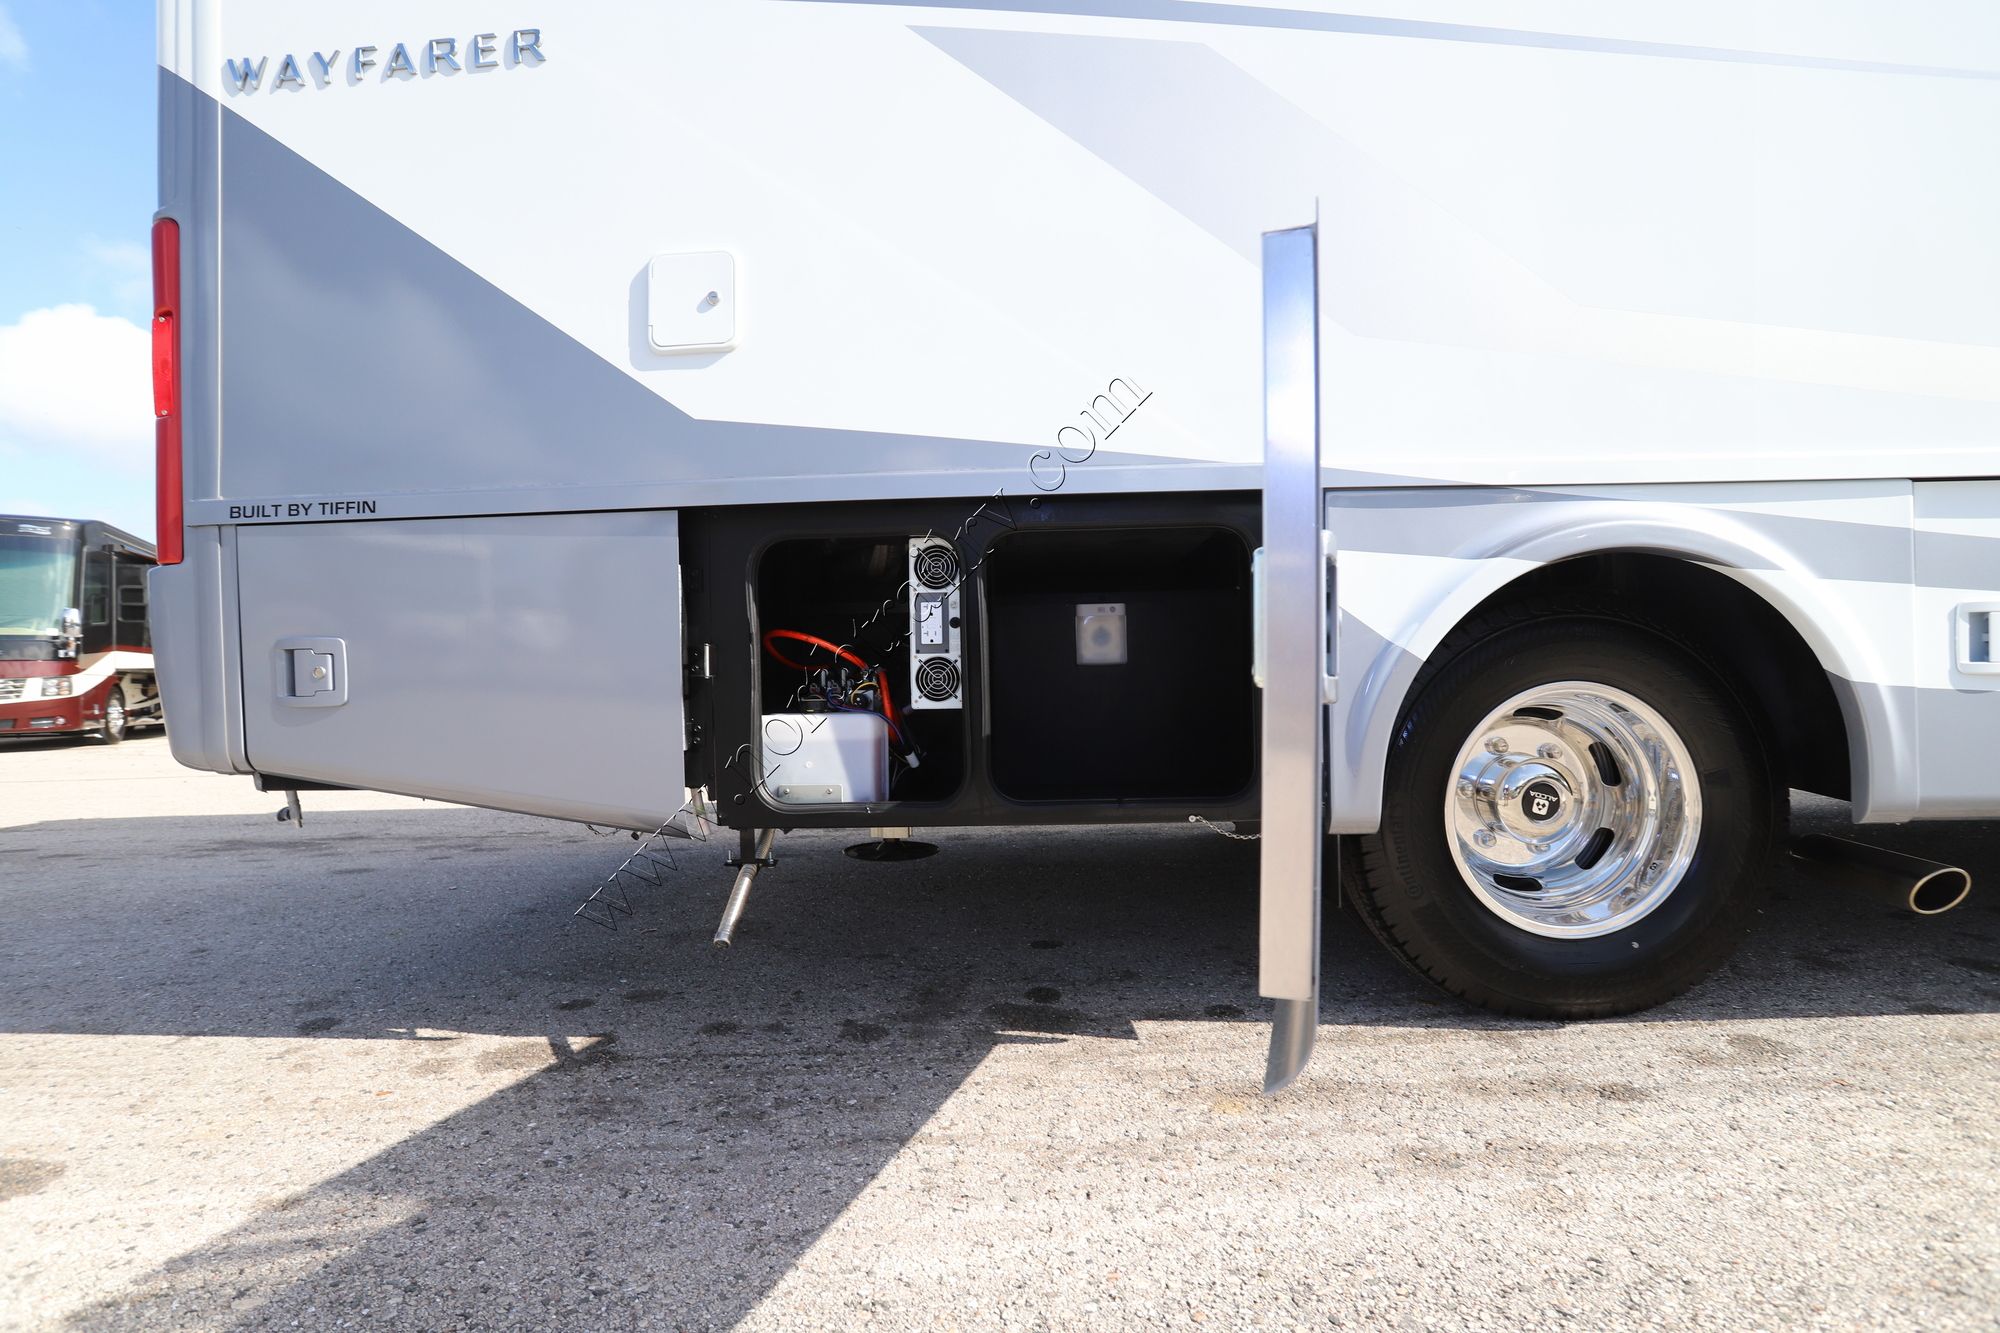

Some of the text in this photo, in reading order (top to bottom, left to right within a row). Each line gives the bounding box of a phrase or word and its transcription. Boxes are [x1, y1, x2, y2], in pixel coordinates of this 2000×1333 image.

[226, 28, 546, 92] WAYFARER
[230, 501, 376, 519] BUILT BY TIFFIN
[1529, 790, 1558, 802] ALCOA
